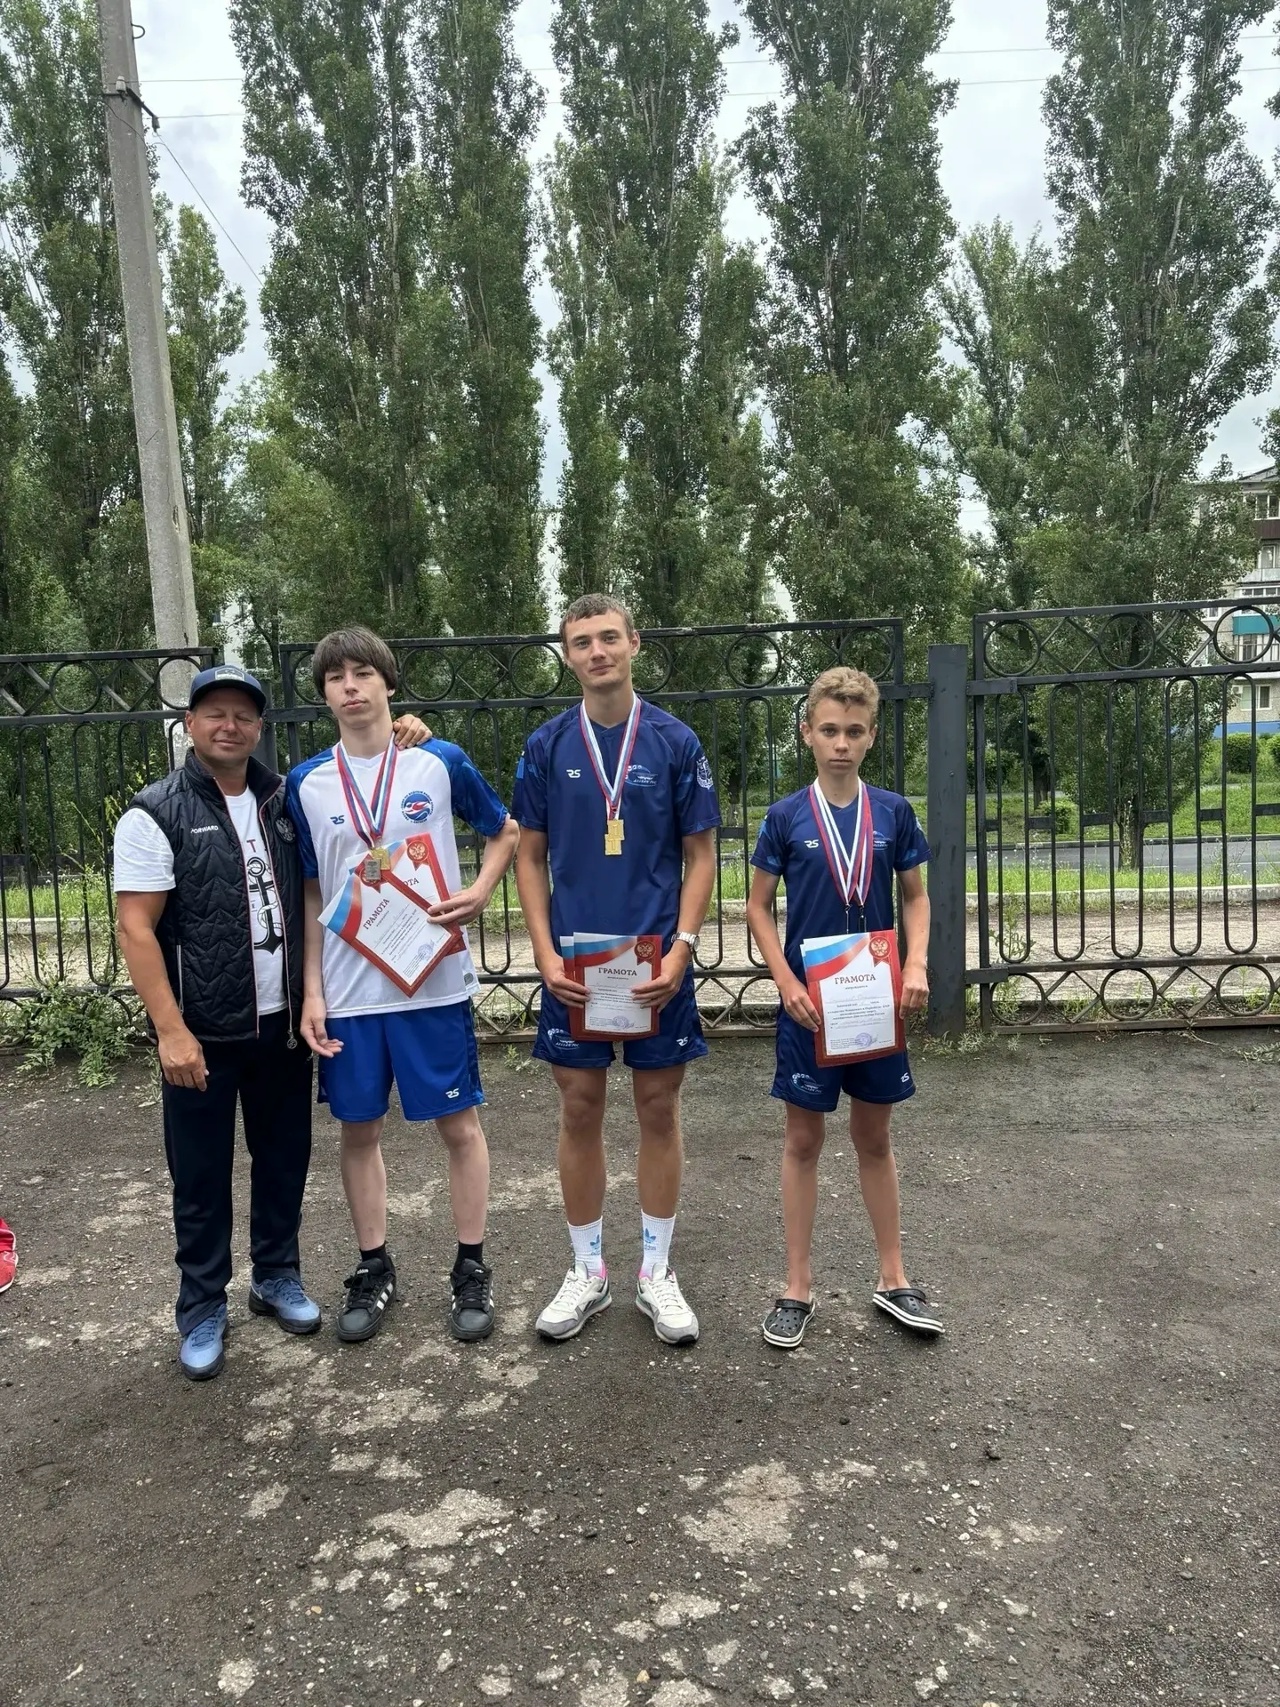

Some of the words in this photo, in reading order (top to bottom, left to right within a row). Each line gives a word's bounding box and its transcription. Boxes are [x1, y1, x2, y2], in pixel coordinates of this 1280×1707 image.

[363, 899, 390, 930] ГРАМОТА
[598, 967, 638, 976] ГРАМОТА
[834, 973, 877, 985] ГРАМОТА
